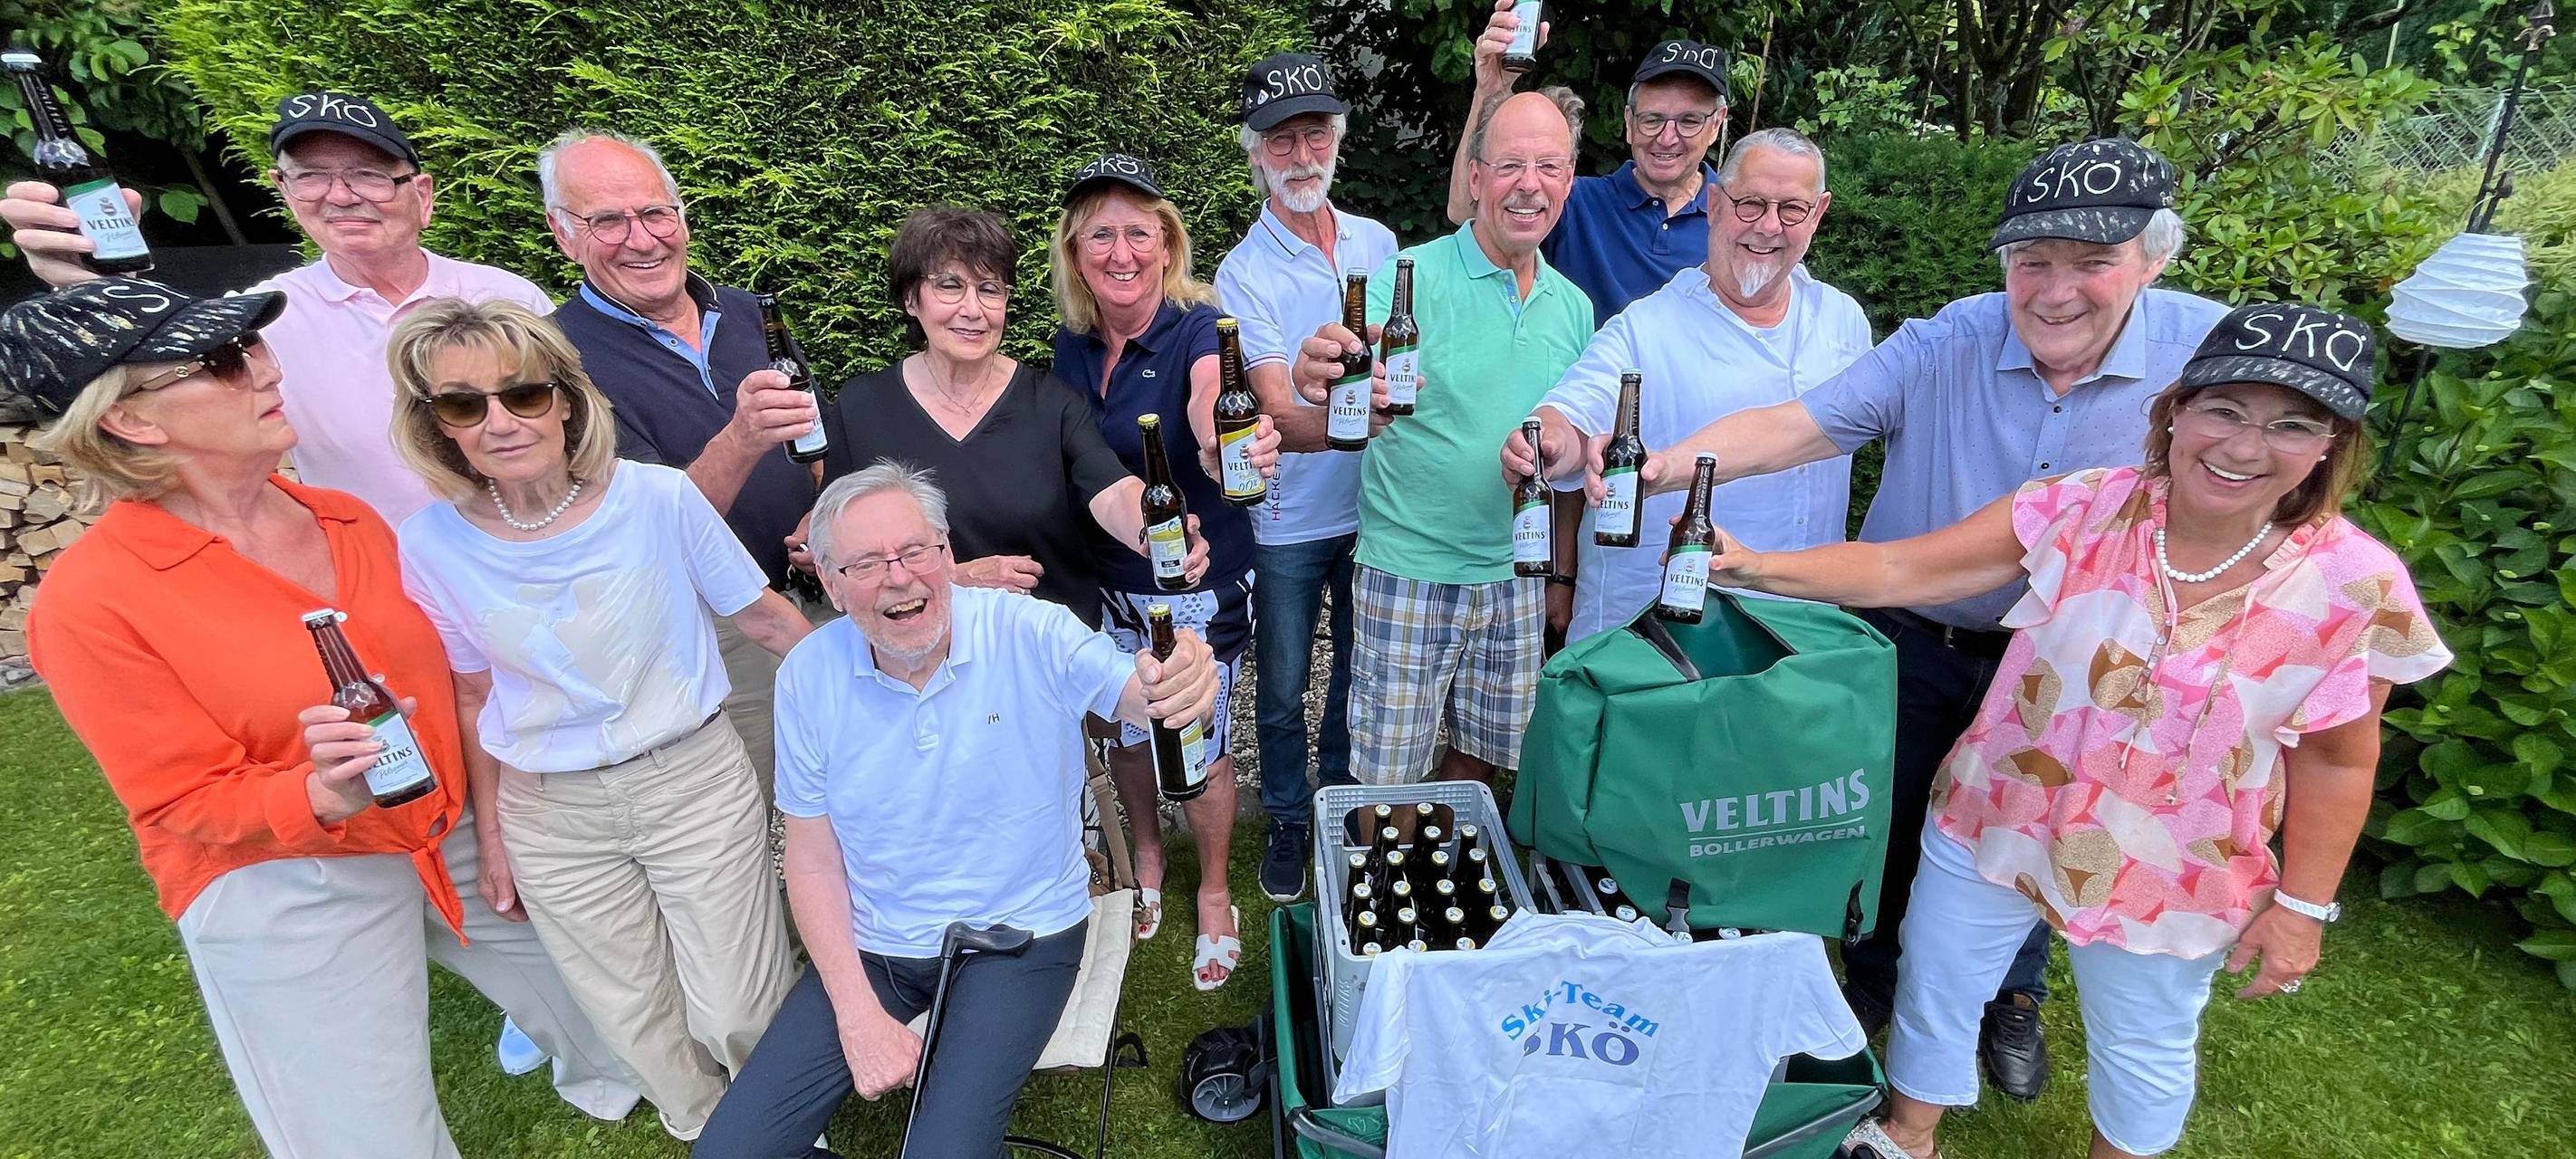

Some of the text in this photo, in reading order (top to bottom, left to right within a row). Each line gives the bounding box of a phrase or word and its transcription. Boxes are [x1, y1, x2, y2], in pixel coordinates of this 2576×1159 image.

[1267, 63, 1322, 99] SKÖ
[2027, 159, 2122, 203] SKÖ
[87, 217, 136, 231] VELTIN
[2235, 313, 2368, 372] SKÖ
[1332, 405, 1367, 417] VELTINS
[1227, 461, 1255, 471] VELTI
[1272, 461, 1282, 521] HACKET
[1600, 499, 1629, 510] ELTINS
[1670, 573, 1705, 588] VELTINS
[368, 746, 414, 770] LTINS
[1679, 768, 1870, 832] VELTINS
[1689, 825, 1866, 857] BOLLERWAGEN
[1501, 981, 1659, 1041] Ski-Team
